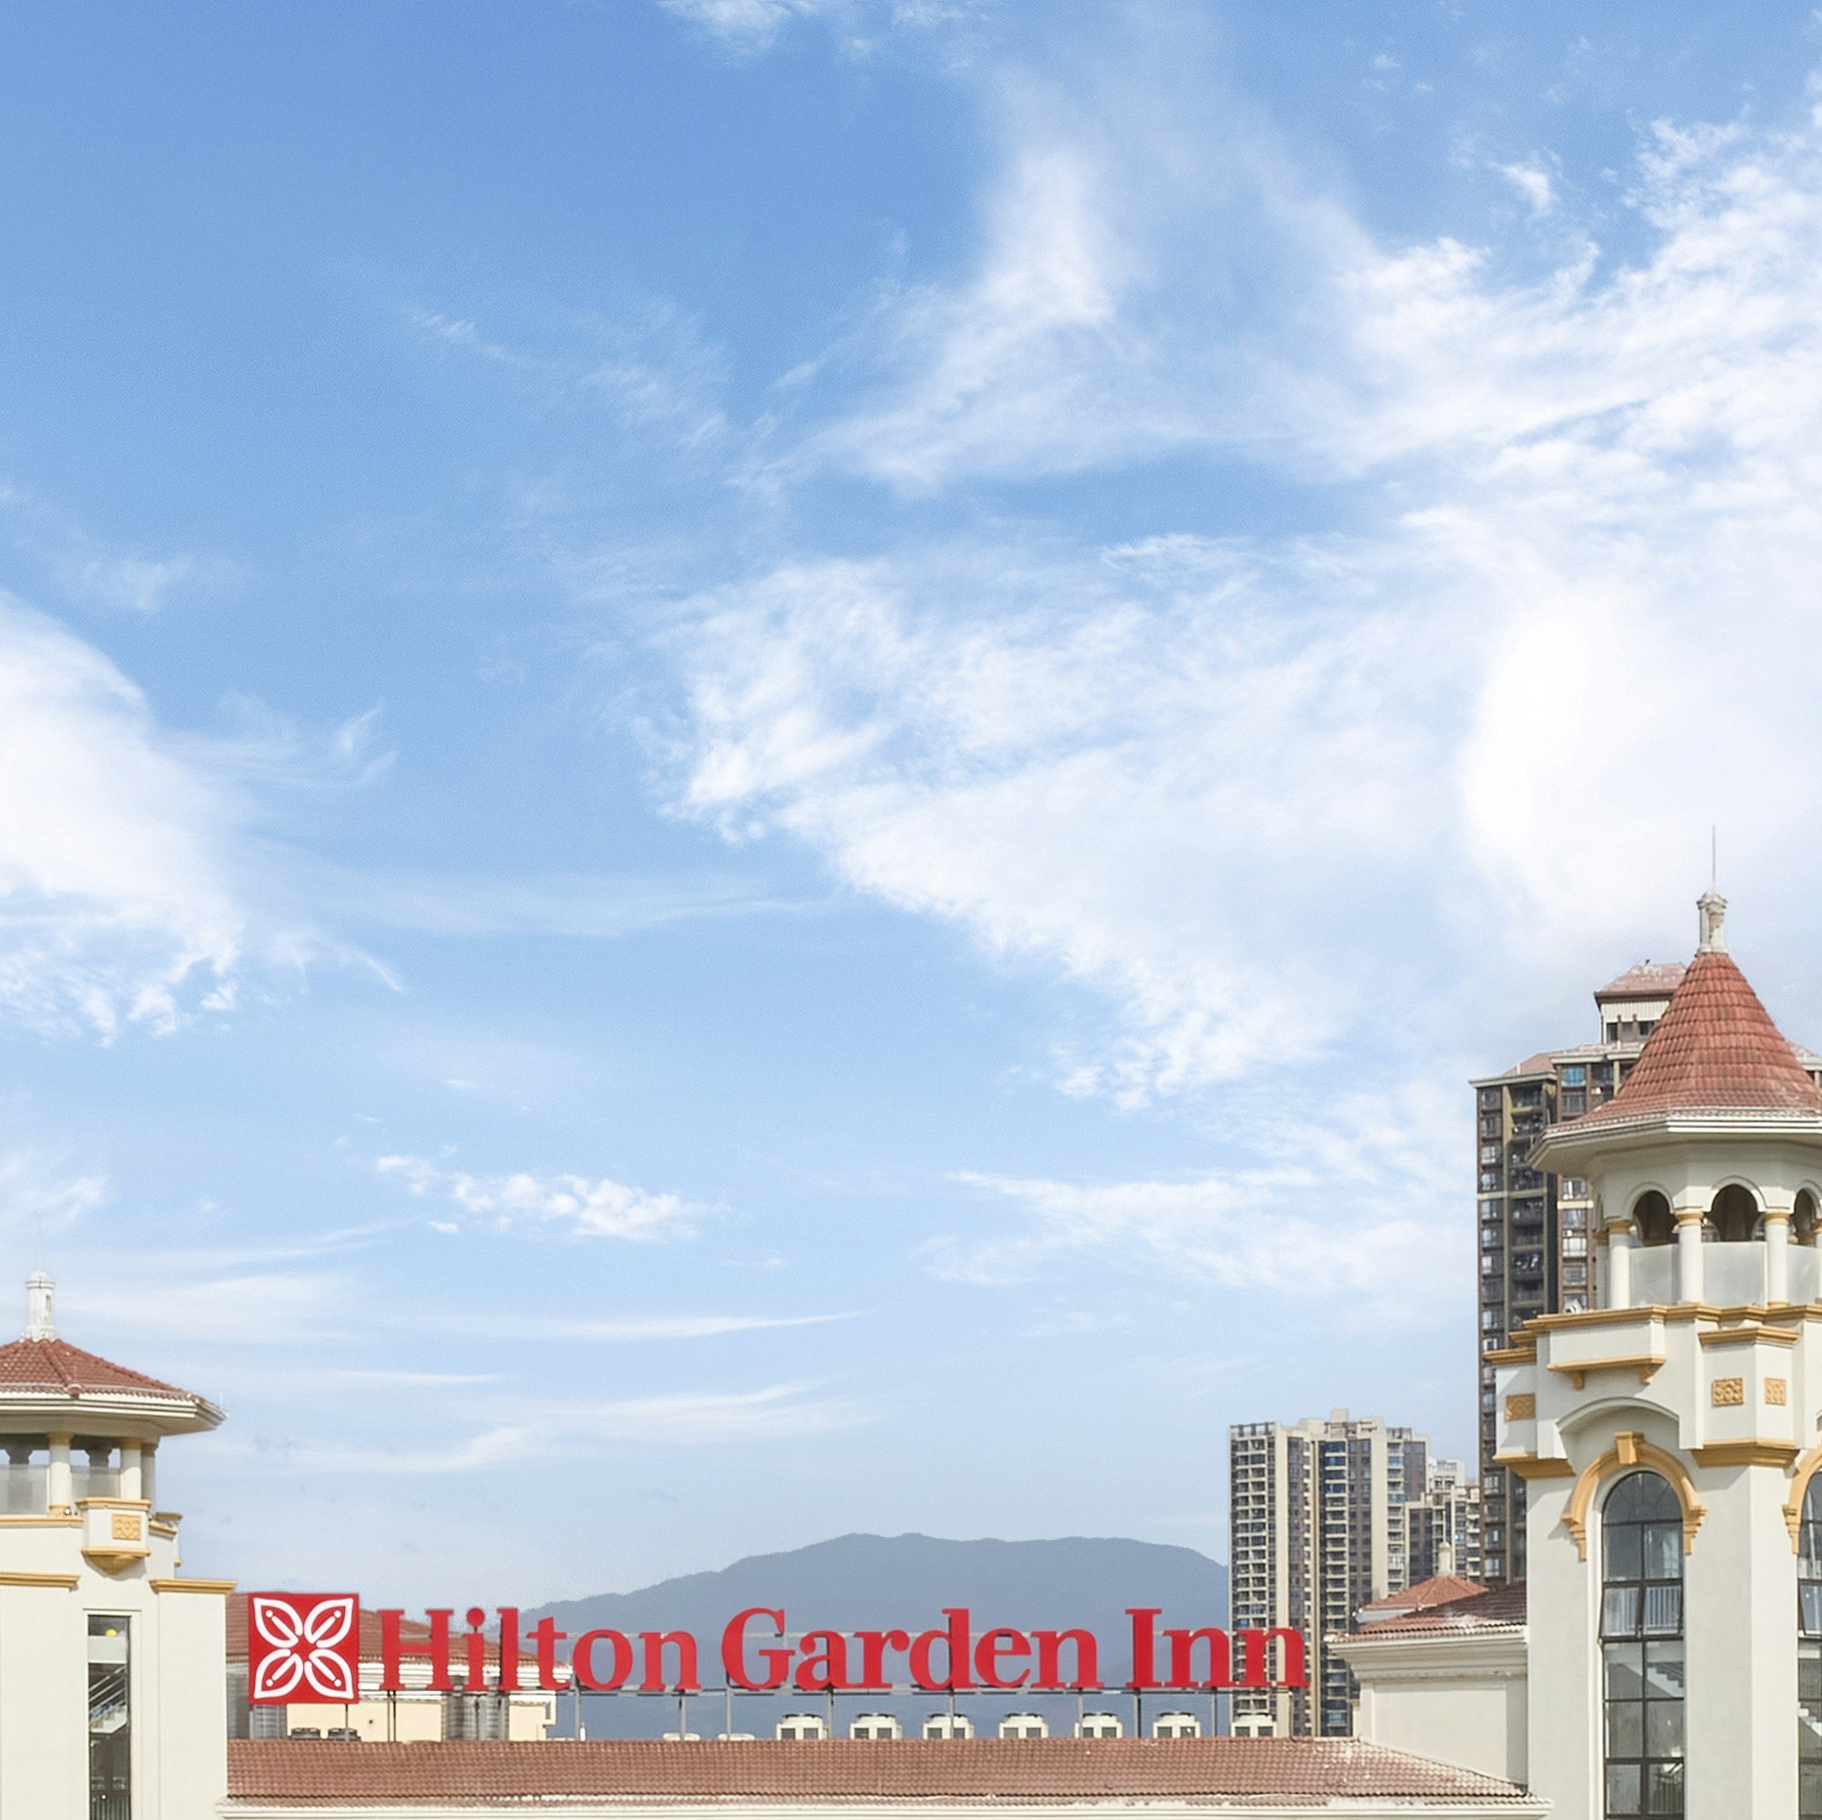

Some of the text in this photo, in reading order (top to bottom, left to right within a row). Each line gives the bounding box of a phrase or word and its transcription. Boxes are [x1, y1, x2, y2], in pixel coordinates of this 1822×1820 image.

[378, 1608, 1311, 1691] Hilton Garden Inn
